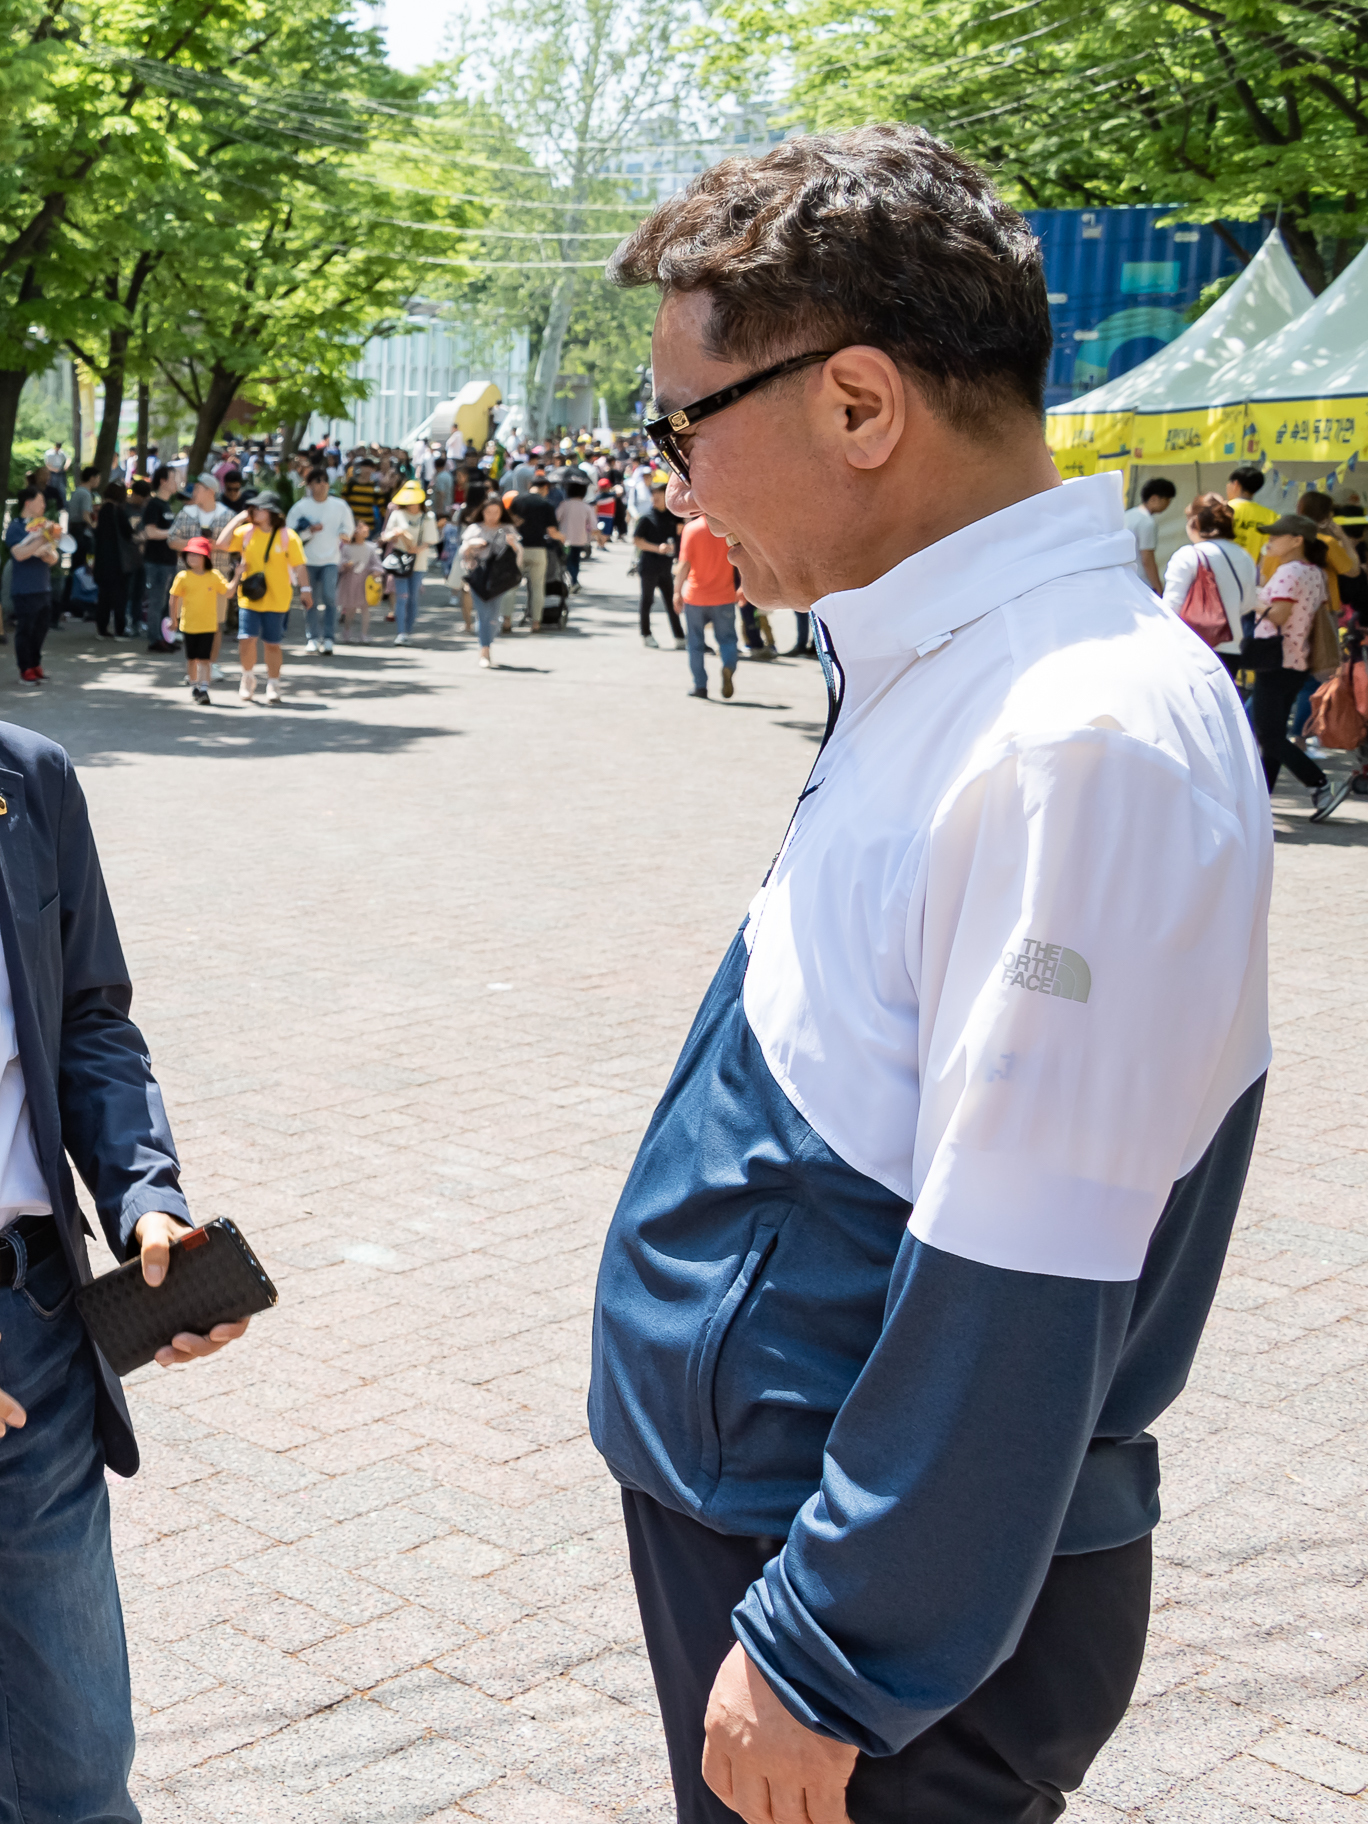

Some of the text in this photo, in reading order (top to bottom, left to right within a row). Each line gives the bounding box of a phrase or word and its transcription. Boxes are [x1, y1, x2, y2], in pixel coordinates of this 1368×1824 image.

[1023, 938, 1062, 962] THE
[1002, 952, 1058, 978] ORTH
[1001, 970, 1053, 995] FACE
